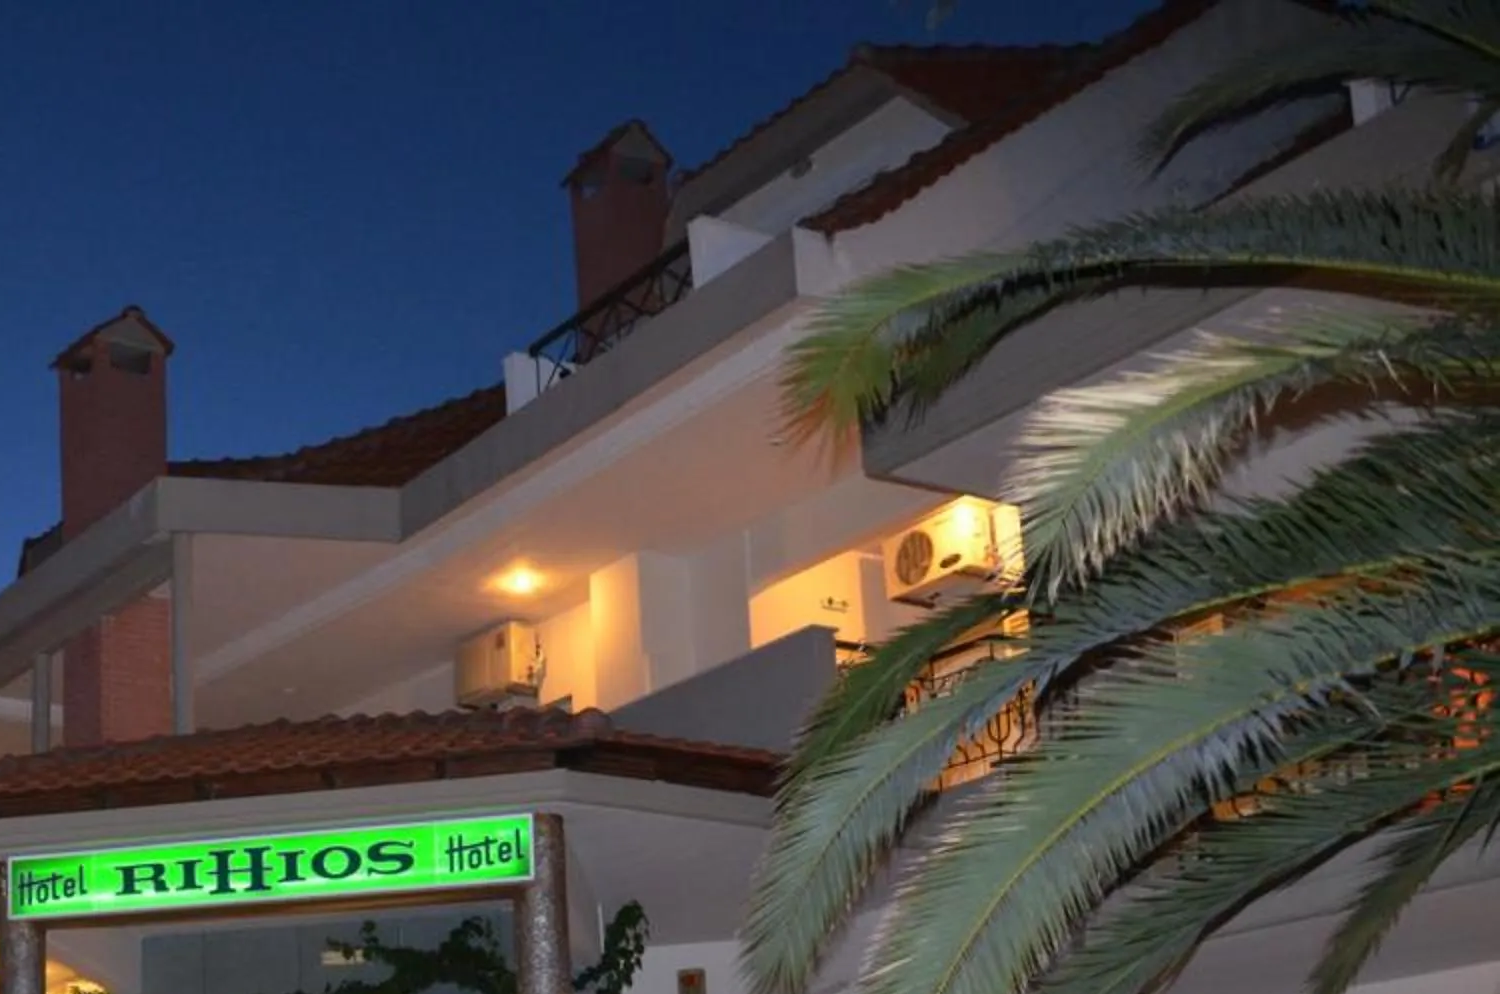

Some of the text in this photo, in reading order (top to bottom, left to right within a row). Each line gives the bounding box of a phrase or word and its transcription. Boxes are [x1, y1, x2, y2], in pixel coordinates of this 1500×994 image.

[18, 828, 524, 906] Hotel RIHIOS Hotel
